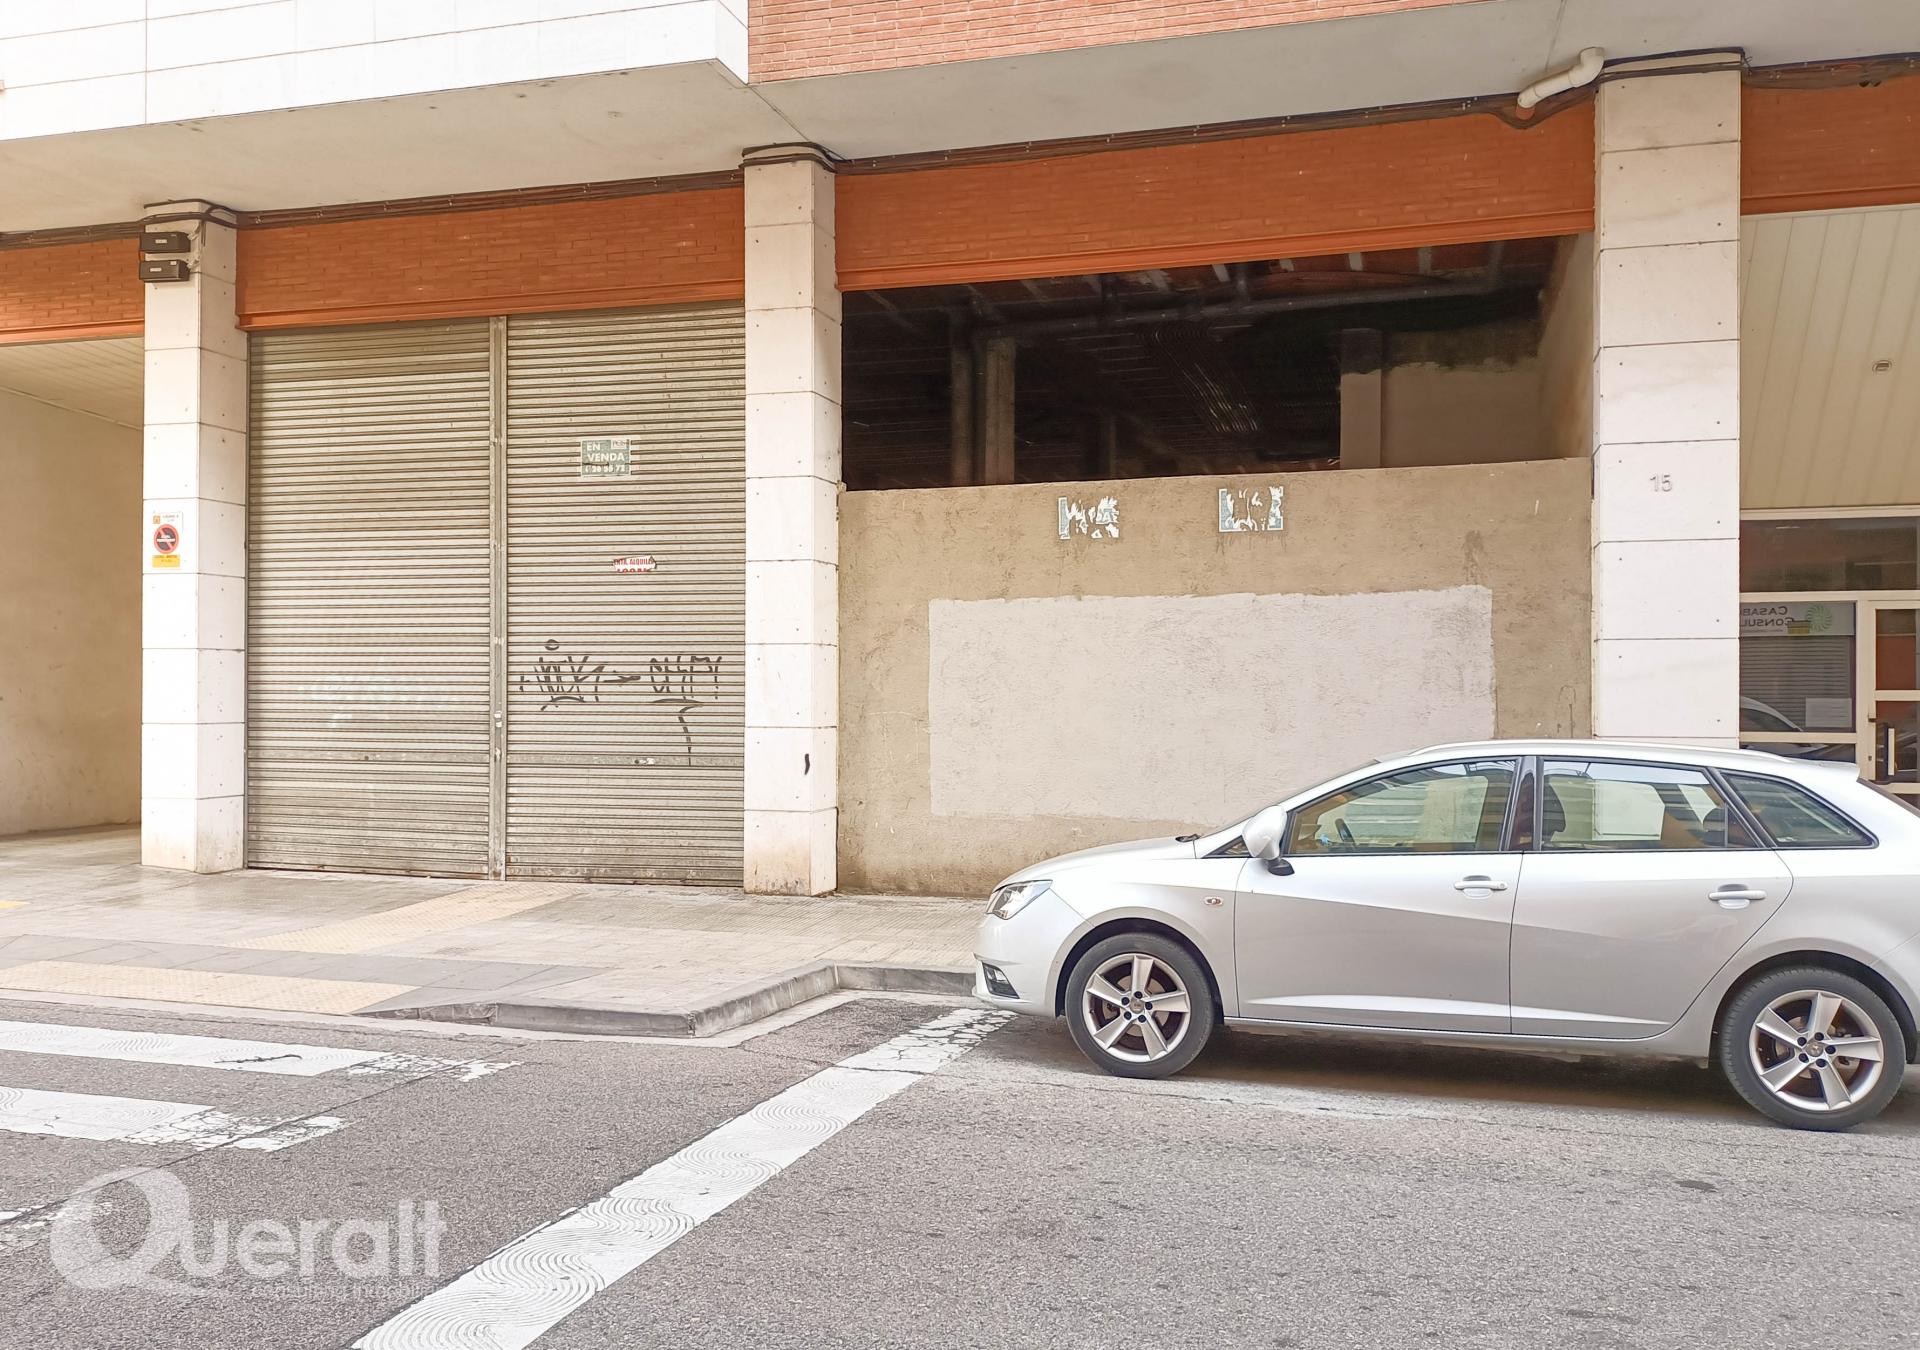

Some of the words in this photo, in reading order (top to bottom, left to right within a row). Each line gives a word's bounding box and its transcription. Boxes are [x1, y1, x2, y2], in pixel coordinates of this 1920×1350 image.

[587, 441, 601, 451] EN
[587, 452, 625, 462] VENDA
[1650, 474, 1673, 492] 15
